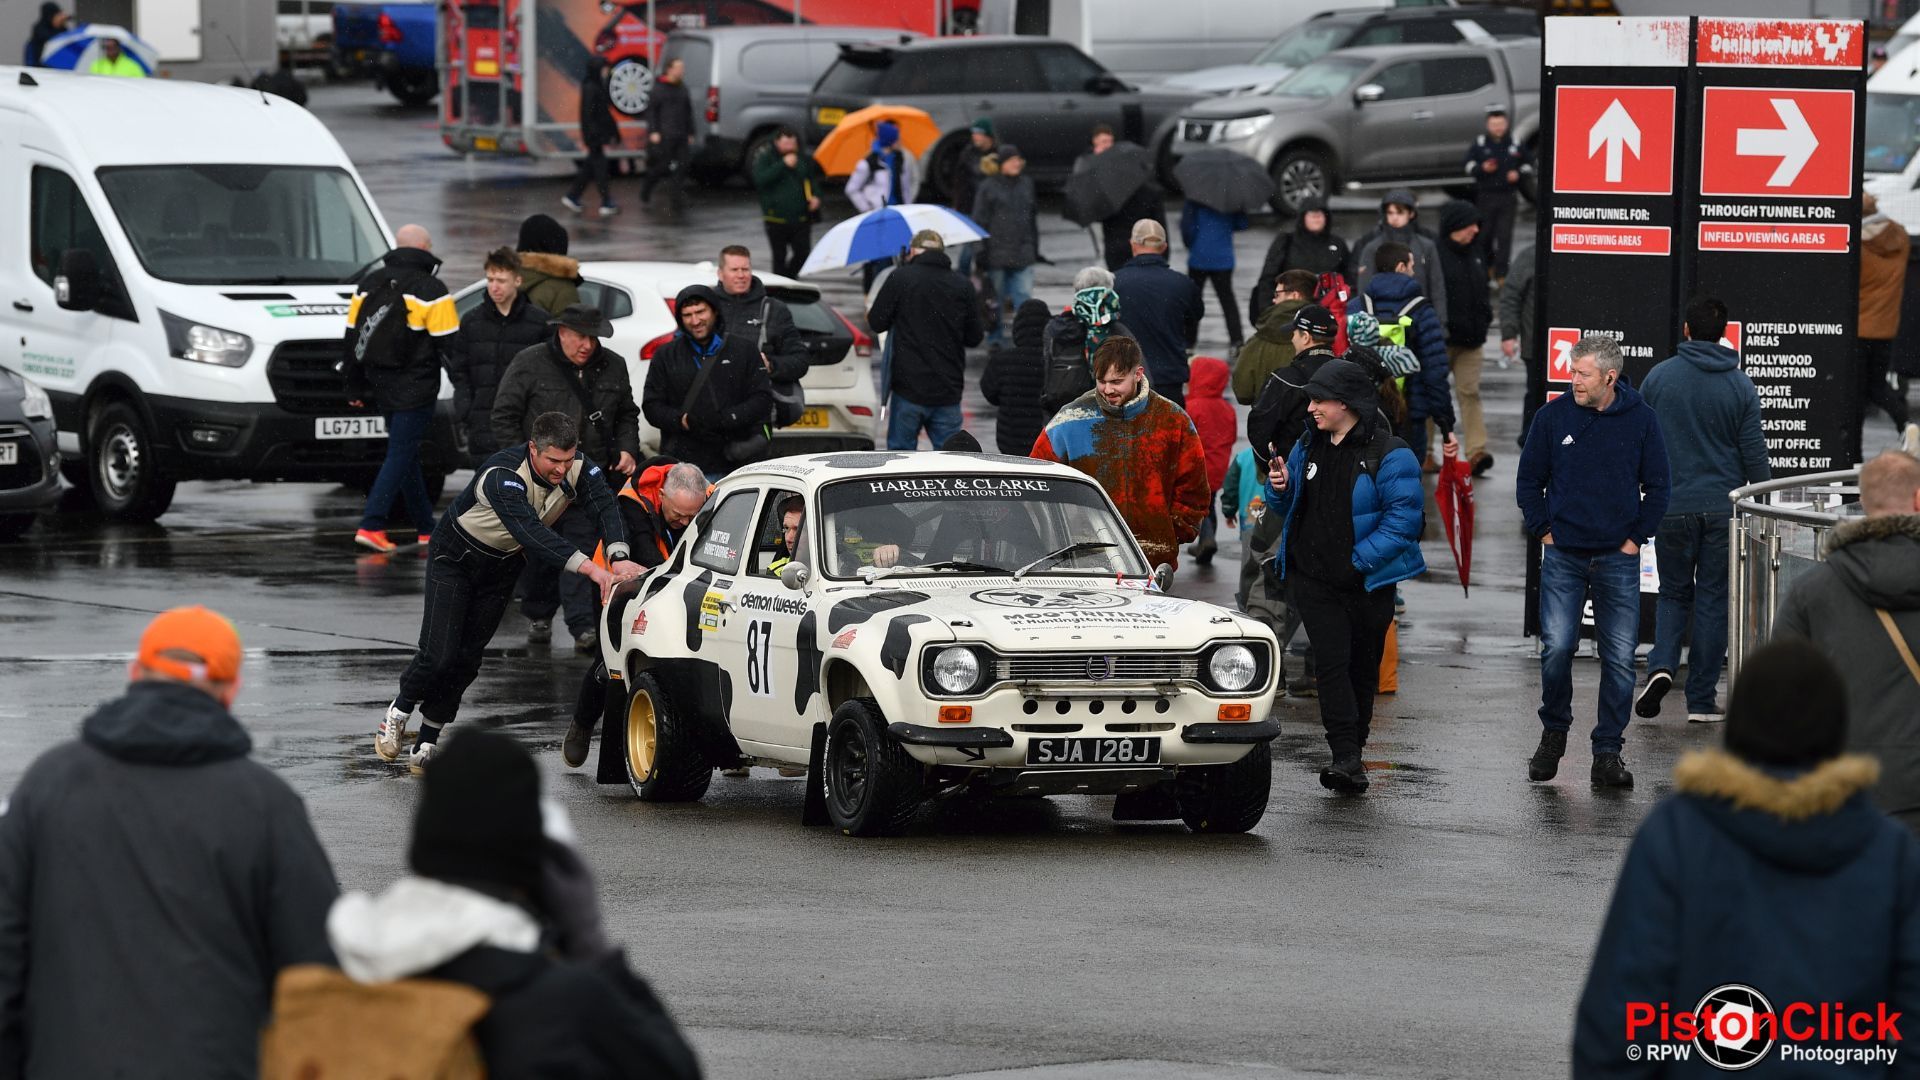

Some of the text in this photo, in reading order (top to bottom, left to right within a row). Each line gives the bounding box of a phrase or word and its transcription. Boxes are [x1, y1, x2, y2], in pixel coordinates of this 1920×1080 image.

[1553, 207, 1650, 221] THROUGH TUNNEL FOR:
[1700, 204, 1836, 219] THROUGH TUNNEL FOR:
[1555, 233, 1642, 247] INFIELD VIEWING AREAS
[1704, 231, 1826, 245] INFIELD VIEWING AREAS
[1746, 323, 1843, 335] OUTFIELD VIEWING
[1615, 331, 1625, 342] 39
[1746, 335, 1780, 346] AREAS
[1631, 346, 1637, 357] &
[1638, 346, 1654, 358] BAR
[1745, 354, 1813, 366] HOLLYWOOD
[1745, 366, 1817, 378] GRANDSTAND
[1756, 385, 1792, 397] DGATE
[1760, 398, 1811, 409] SPITALITY
[322, 419, 387, 436] LG73 TL
[1761, 419, 1807, 431] GASTORE
[1785, 438, 1821, 450] OFFICE
[1799, 457, 1808, 469] &
[1809, 457, 1832, 469] EXIT
[869, 478, 1050, 493] HARLEY & CLARKE
[904, 489, 1022, 498] CONSTRUCTION LTD
[740, 591, 808, 616] demon tweeks
[747, 619, 772, 694] 87
[1038, 740, 1150, 762] SJA 128J
